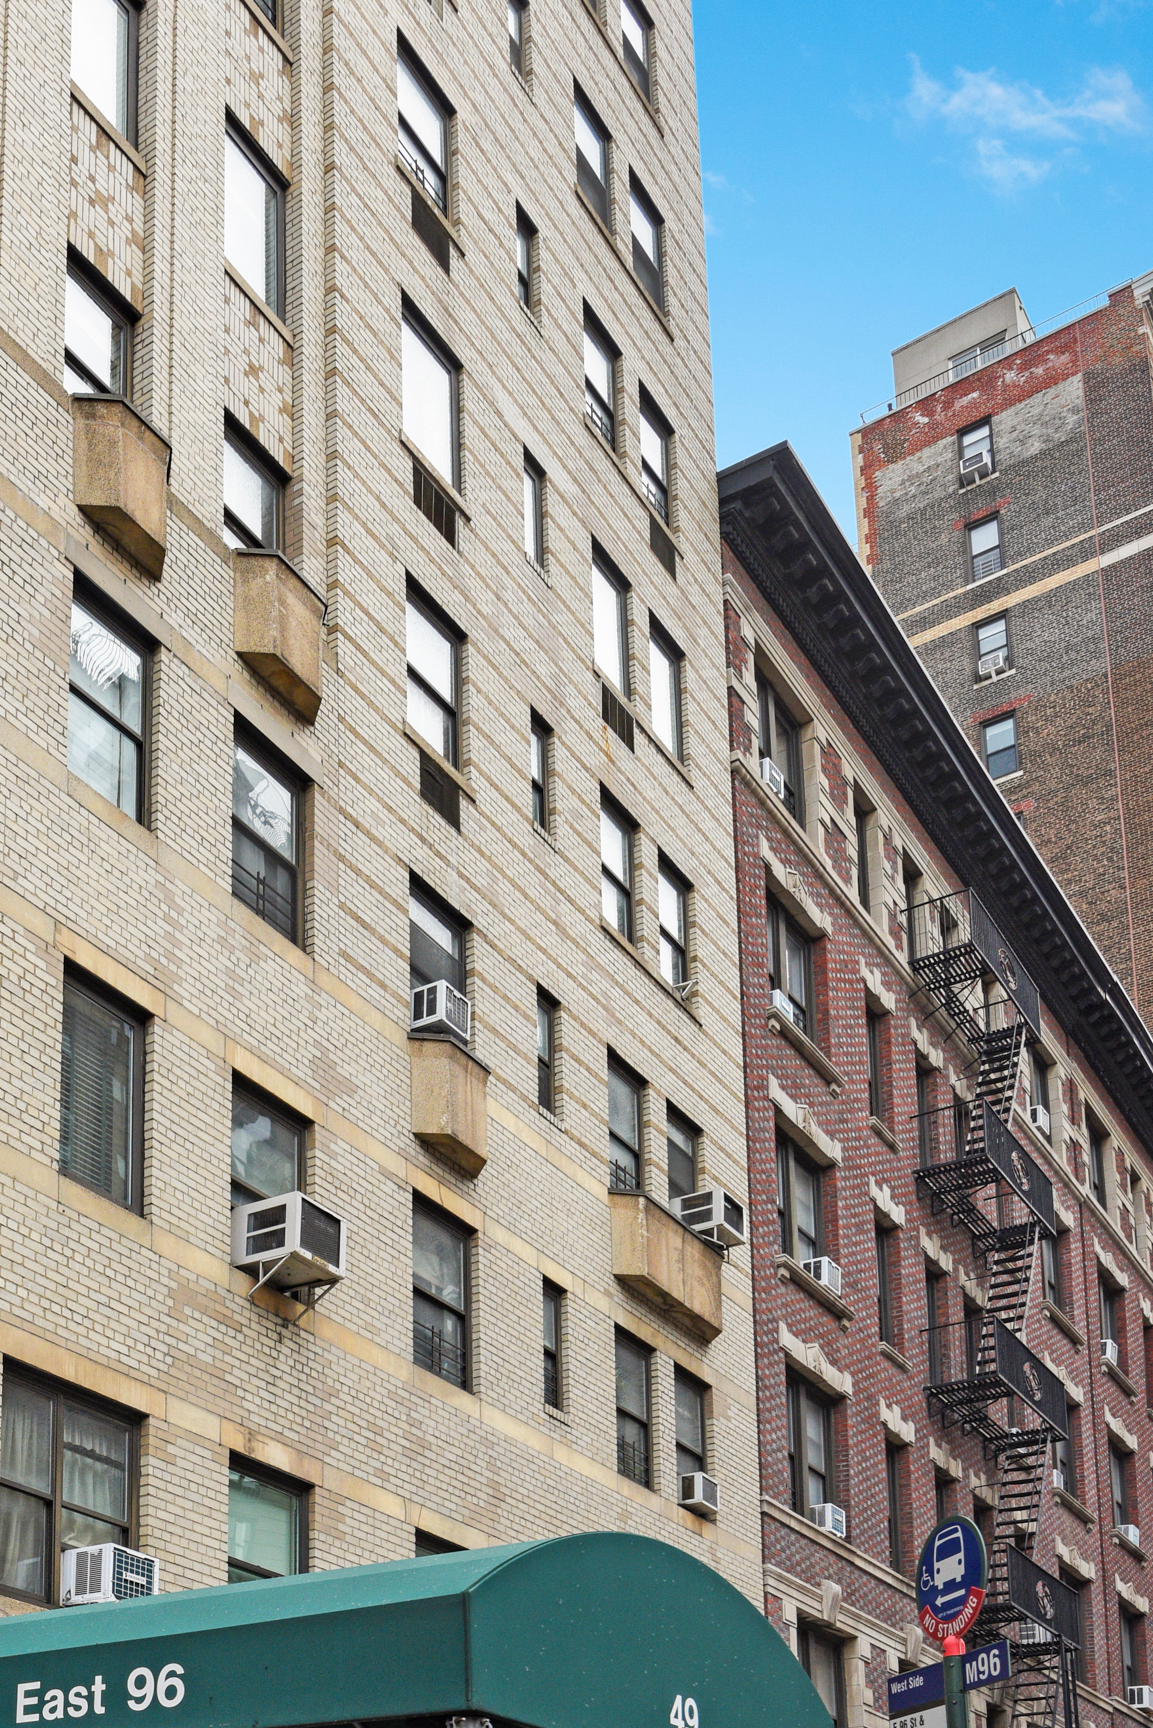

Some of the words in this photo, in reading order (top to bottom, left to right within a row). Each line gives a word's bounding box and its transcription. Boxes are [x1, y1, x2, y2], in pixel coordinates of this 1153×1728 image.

[923, 1613, 936, 1633] NO
[937, 1595, 978, 1638] STANDING
[890, 1679, 908, 1695] West
[908, 1674, 924, 1689] Side
[965, 1648, 1001, 1685] M96
[15, 1674, 107, 1724] East
[126, 1662, 186, 1712] 96
[909, 1716, 918, 1728] St
[919, 1715, 925, 1726] &
